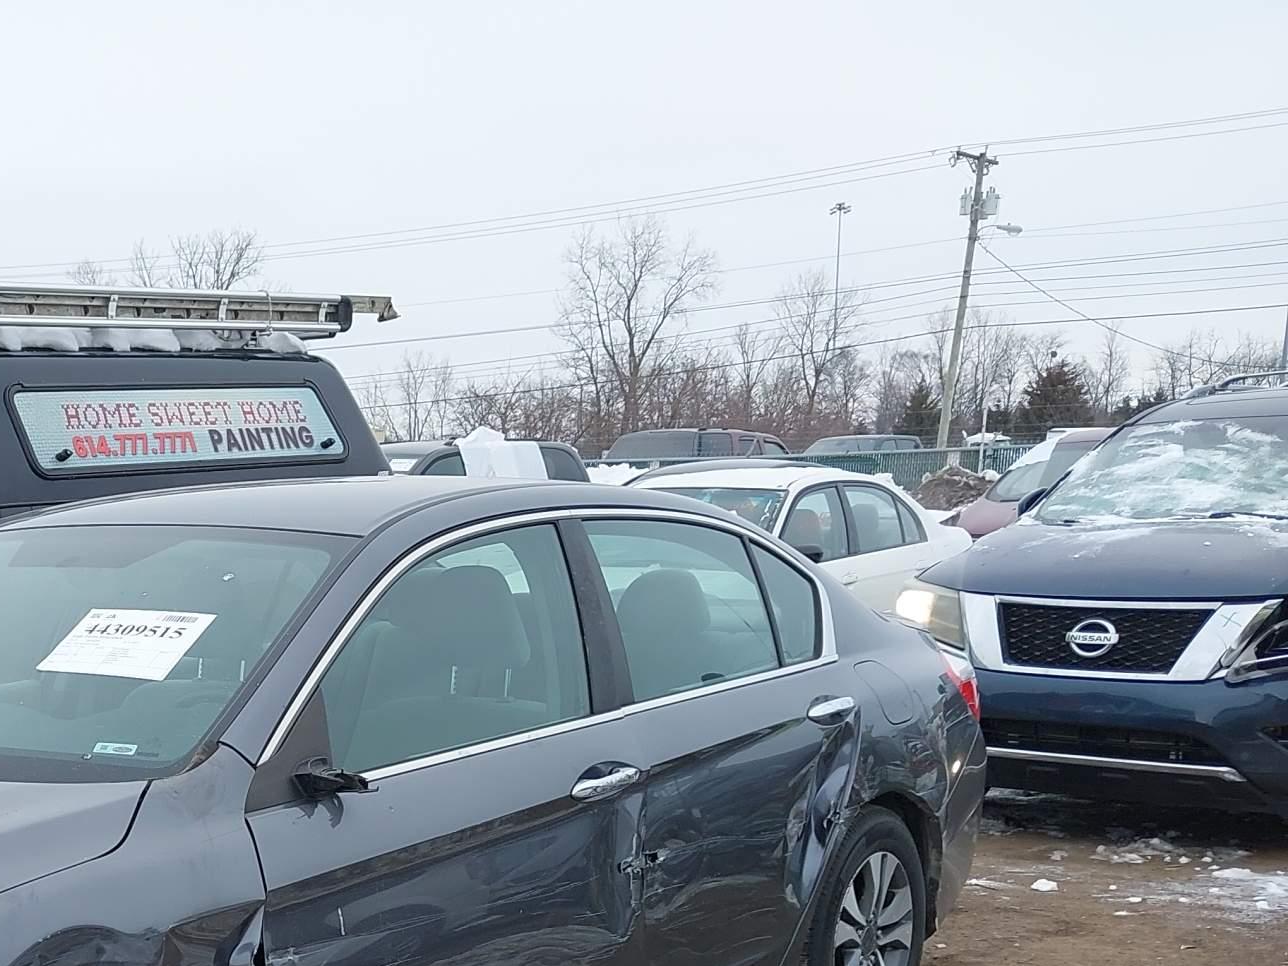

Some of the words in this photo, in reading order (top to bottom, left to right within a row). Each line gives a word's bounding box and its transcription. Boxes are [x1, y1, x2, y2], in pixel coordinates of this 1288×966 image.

[62, 402, 143, 430] HOME
[147, 401, 232, 427] SWEET
[237, 400, 308, 425] HOME
[72, 431, 198, 458] 614.777.7771
[207, 425, 315, 453] PAINTING
[84, 623, 188, 639] 44309515
[1070, 634, 1112, 642] NISSAN
